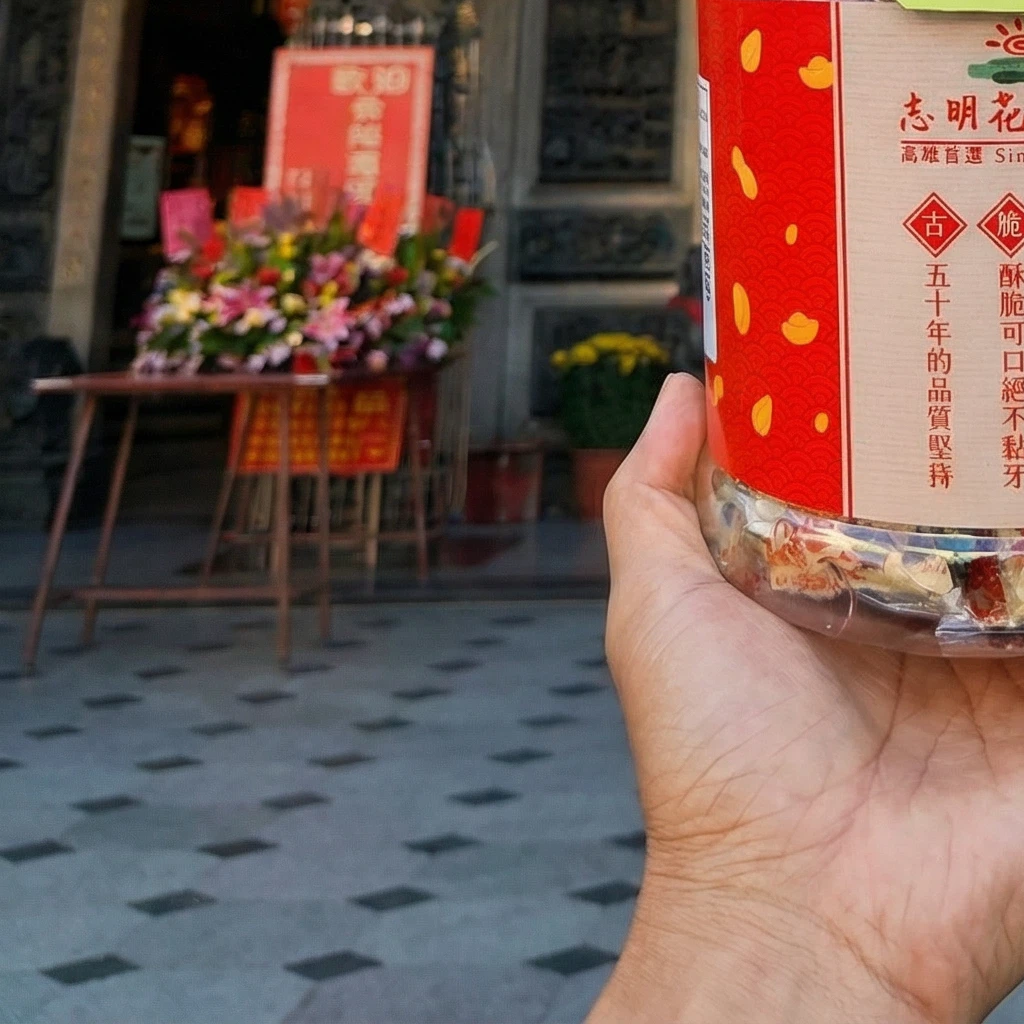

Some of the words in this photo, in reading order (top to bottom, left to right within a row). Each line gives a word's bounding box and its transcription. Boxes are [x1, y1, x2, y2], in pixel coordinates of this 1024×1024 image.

[921, 211, 948, 238] 古
[997, 211, 1023, 238] 脆
[924, 262, 953, 489] 五十年的品質堅持
